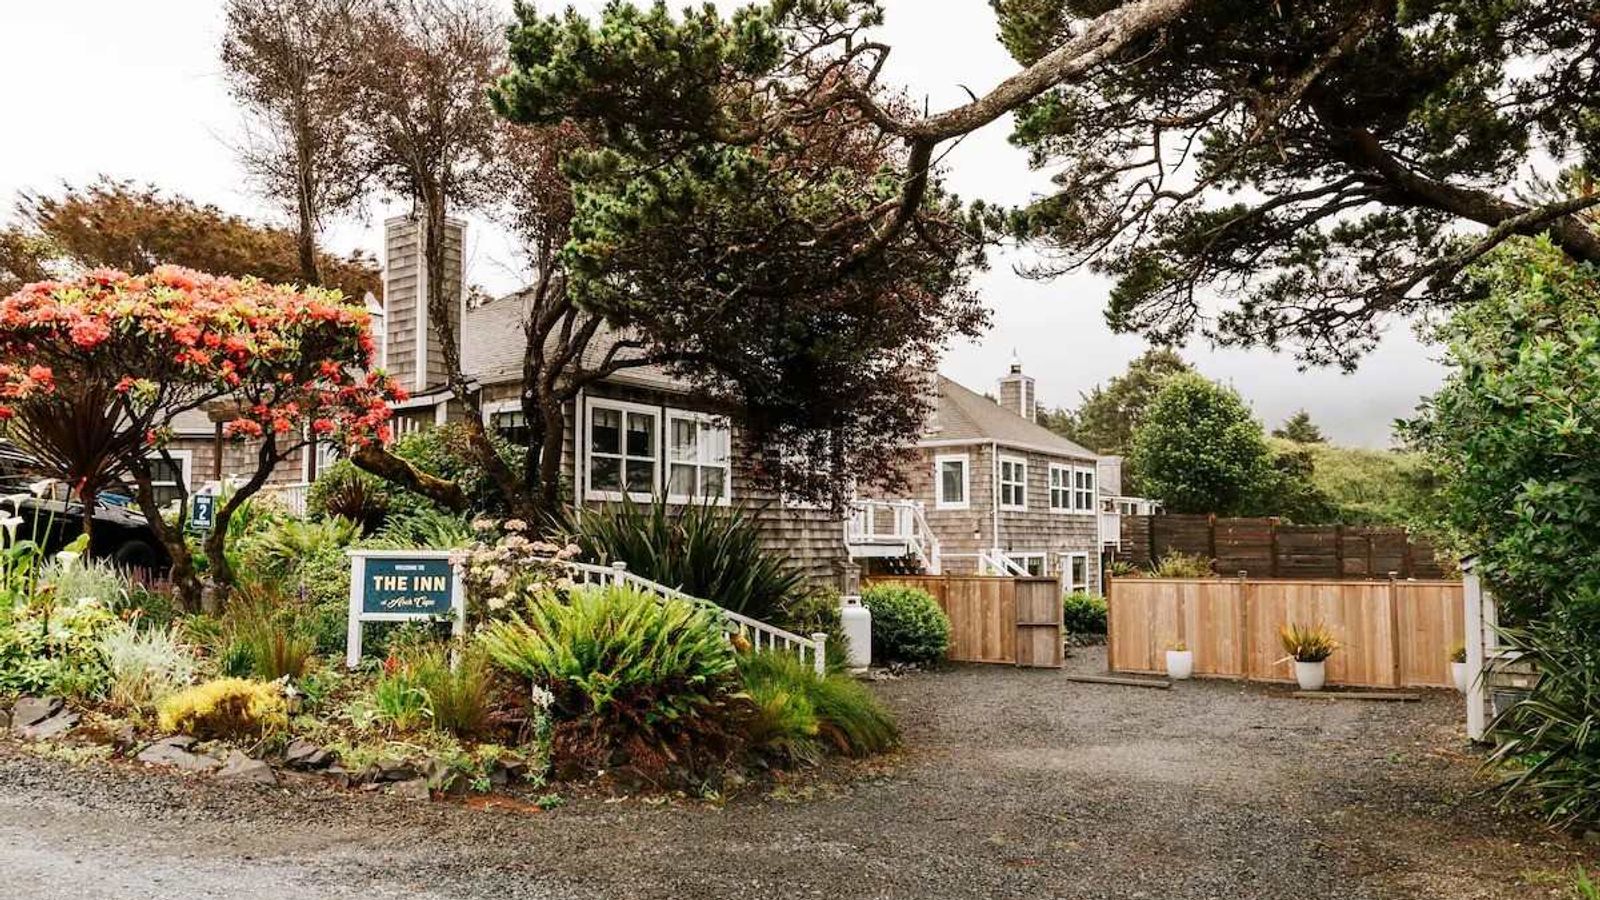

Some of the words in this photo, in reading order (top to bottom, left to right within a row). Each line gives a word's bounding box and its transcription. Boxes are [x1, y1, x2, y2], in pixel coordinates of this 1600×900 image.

[199, 504, 207, 520] 2
[373, 576, 408, 591] THE
[413, 576, 446, 591] INN
